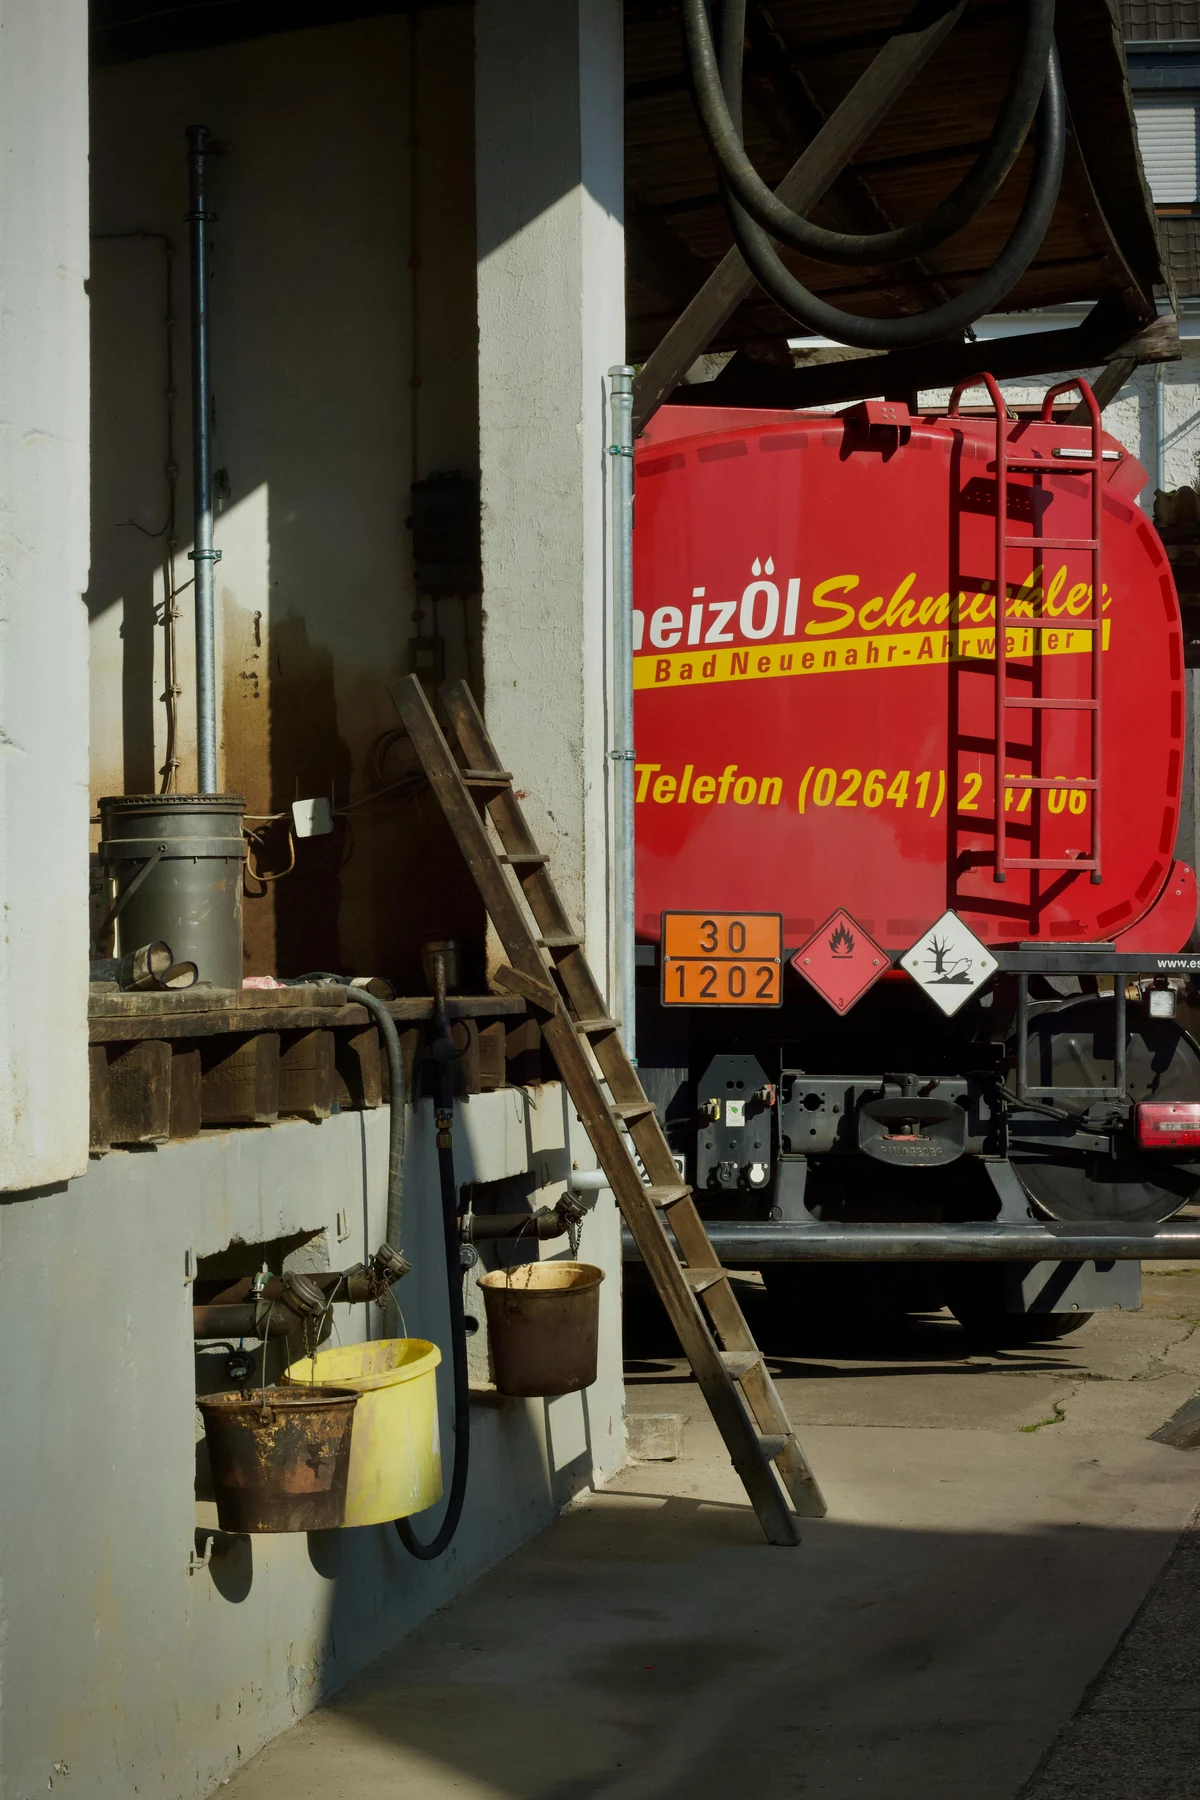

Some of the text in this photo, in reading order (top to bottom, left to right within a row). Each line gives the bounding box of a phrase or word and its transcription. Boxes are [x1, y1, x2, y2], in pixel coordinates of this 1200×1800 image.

[654, 654, 717, 683] Bad
[634, 763, 783, 804] Telefon
[798, 766, 946, 817] (02641)
[957, 772, 983, 810] 2
[700, 919, 746, 953] 30
[675, 965, 774, 999] 1202
[838, 997, 844, 1007] 3
